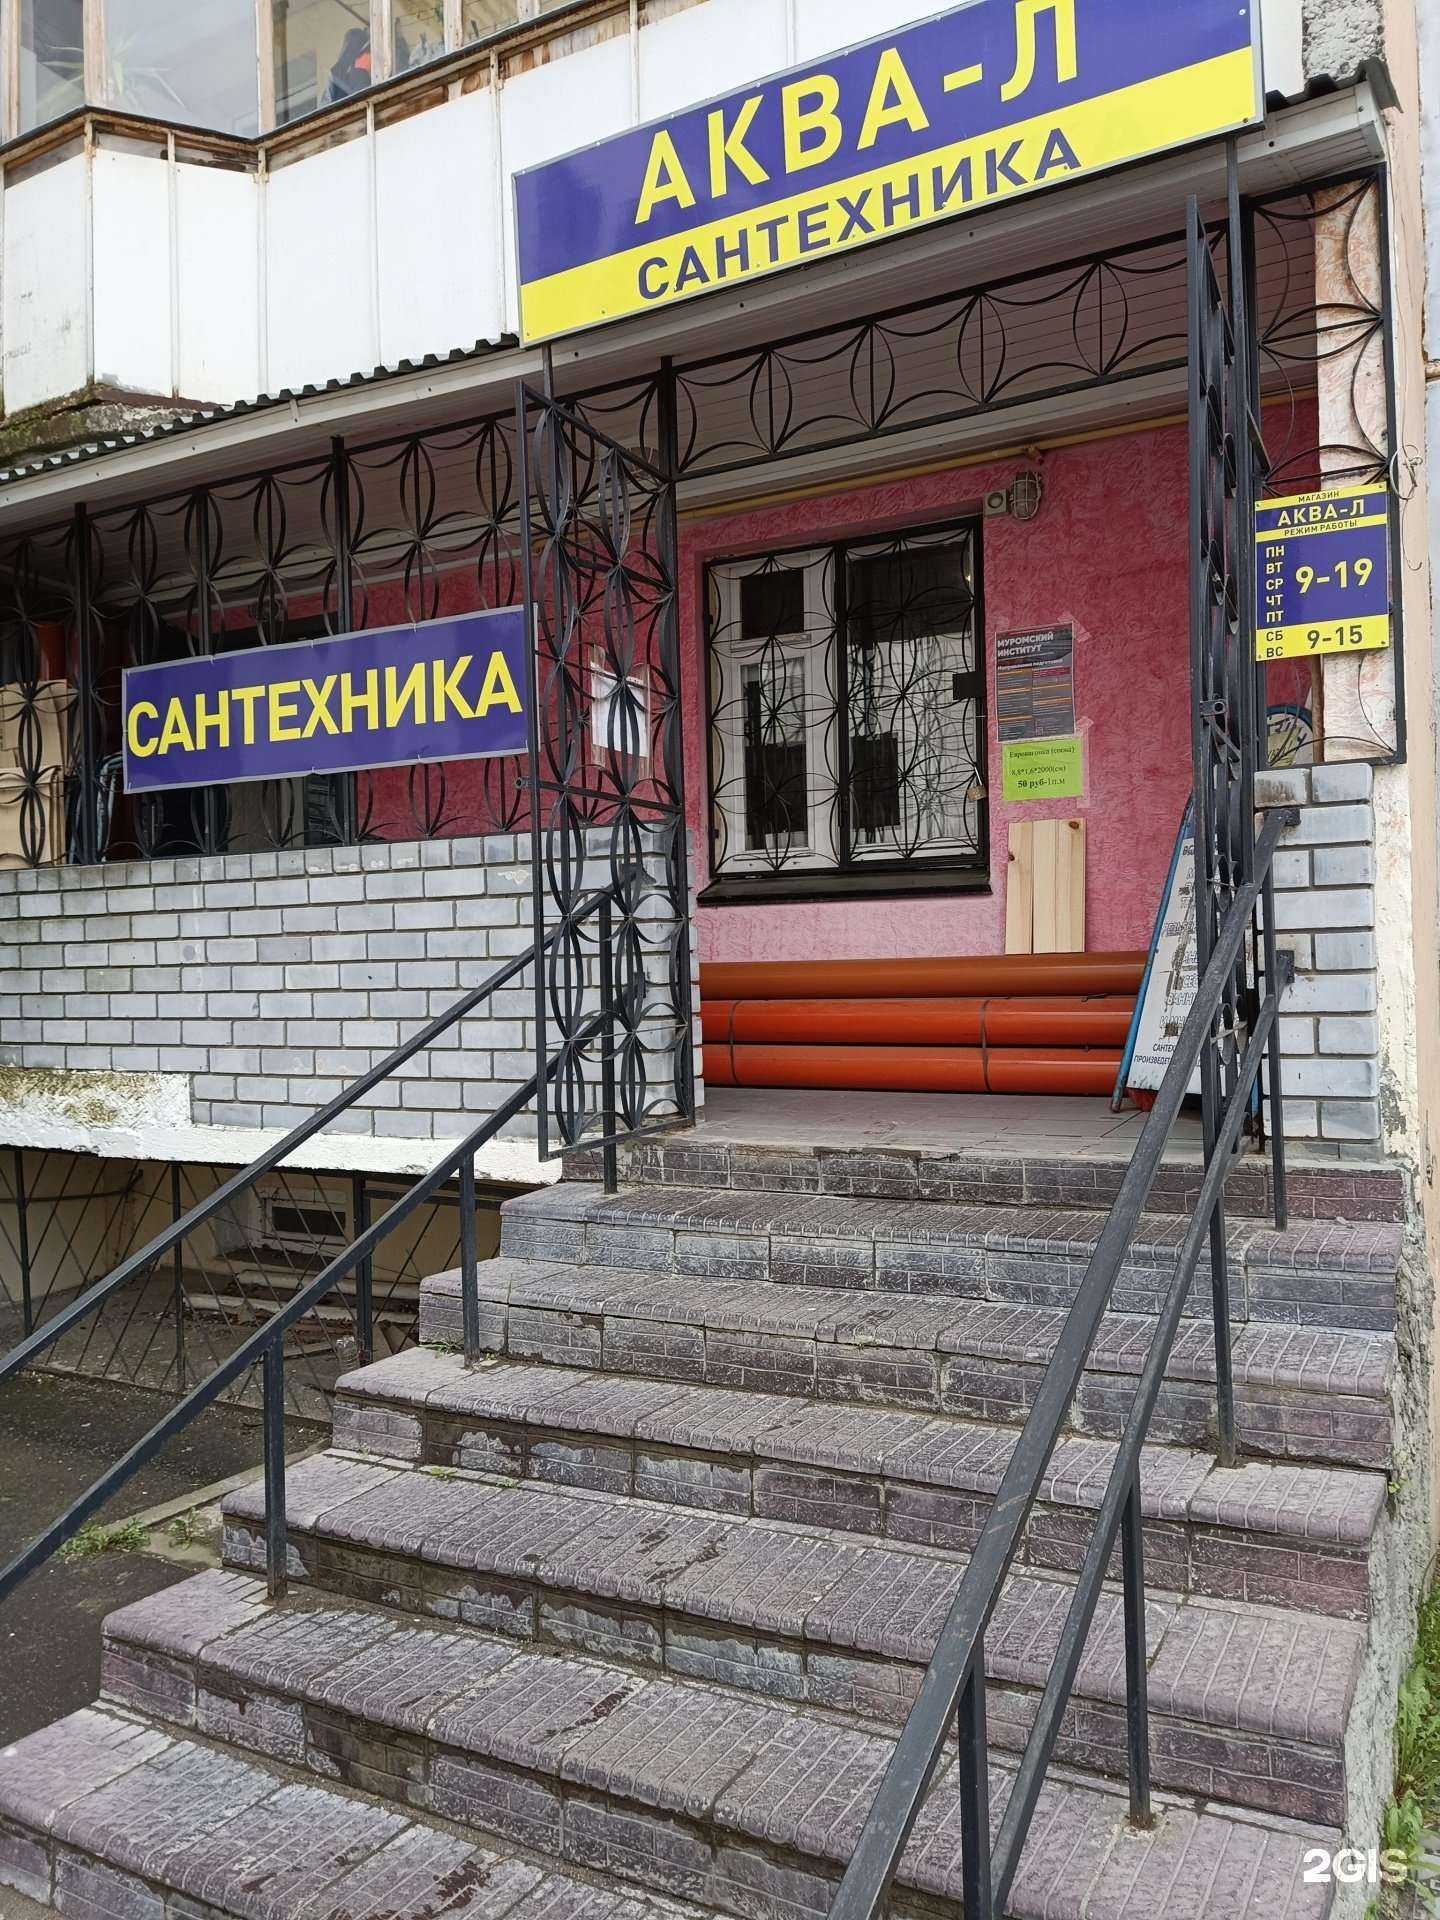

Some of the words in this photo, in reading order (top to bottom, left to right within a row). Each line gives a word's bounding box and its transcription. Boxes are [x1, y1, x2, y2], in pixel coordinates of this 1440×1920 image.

[634, 0, 1078, 225] АКВА-Л
[638, 127, 1081, 301] САНТЕХНИКА
[1298, 490, 1340, 504] МАГАЗИН
[1277, 499, 1365, 527] АКВА-Л
[1284, 525, 1318, 537] РЕЖИМ
[1320, 519, 1358, 532] РАБОТЫ
[1265, 545, 1285, 559] ПН
[1266, 562, 1284, 575] ВТ
[1295, 557, 1373, 594] 9-19
[1265, 579, 1284, 591] СР
[1266, 594, 1284, 606] ЧТ
[1266, 611, 1284, 623] ПТ
[997, 631, 1054, 648] МУРОМСКИЙ
[1266, 630, 1284, 642] СБ
[1306, 624, 1363, 649] 9-15
[997, 644, 1042, 657] ИНСТИТУТ
[1266, 646, 1284, 658] ВС
[127, 650, 523, 758] САНТЕХНИКА
[1017, 780, 1028, 789] 50
[1152, 1043, 1177, 1052] САНТЕХ
